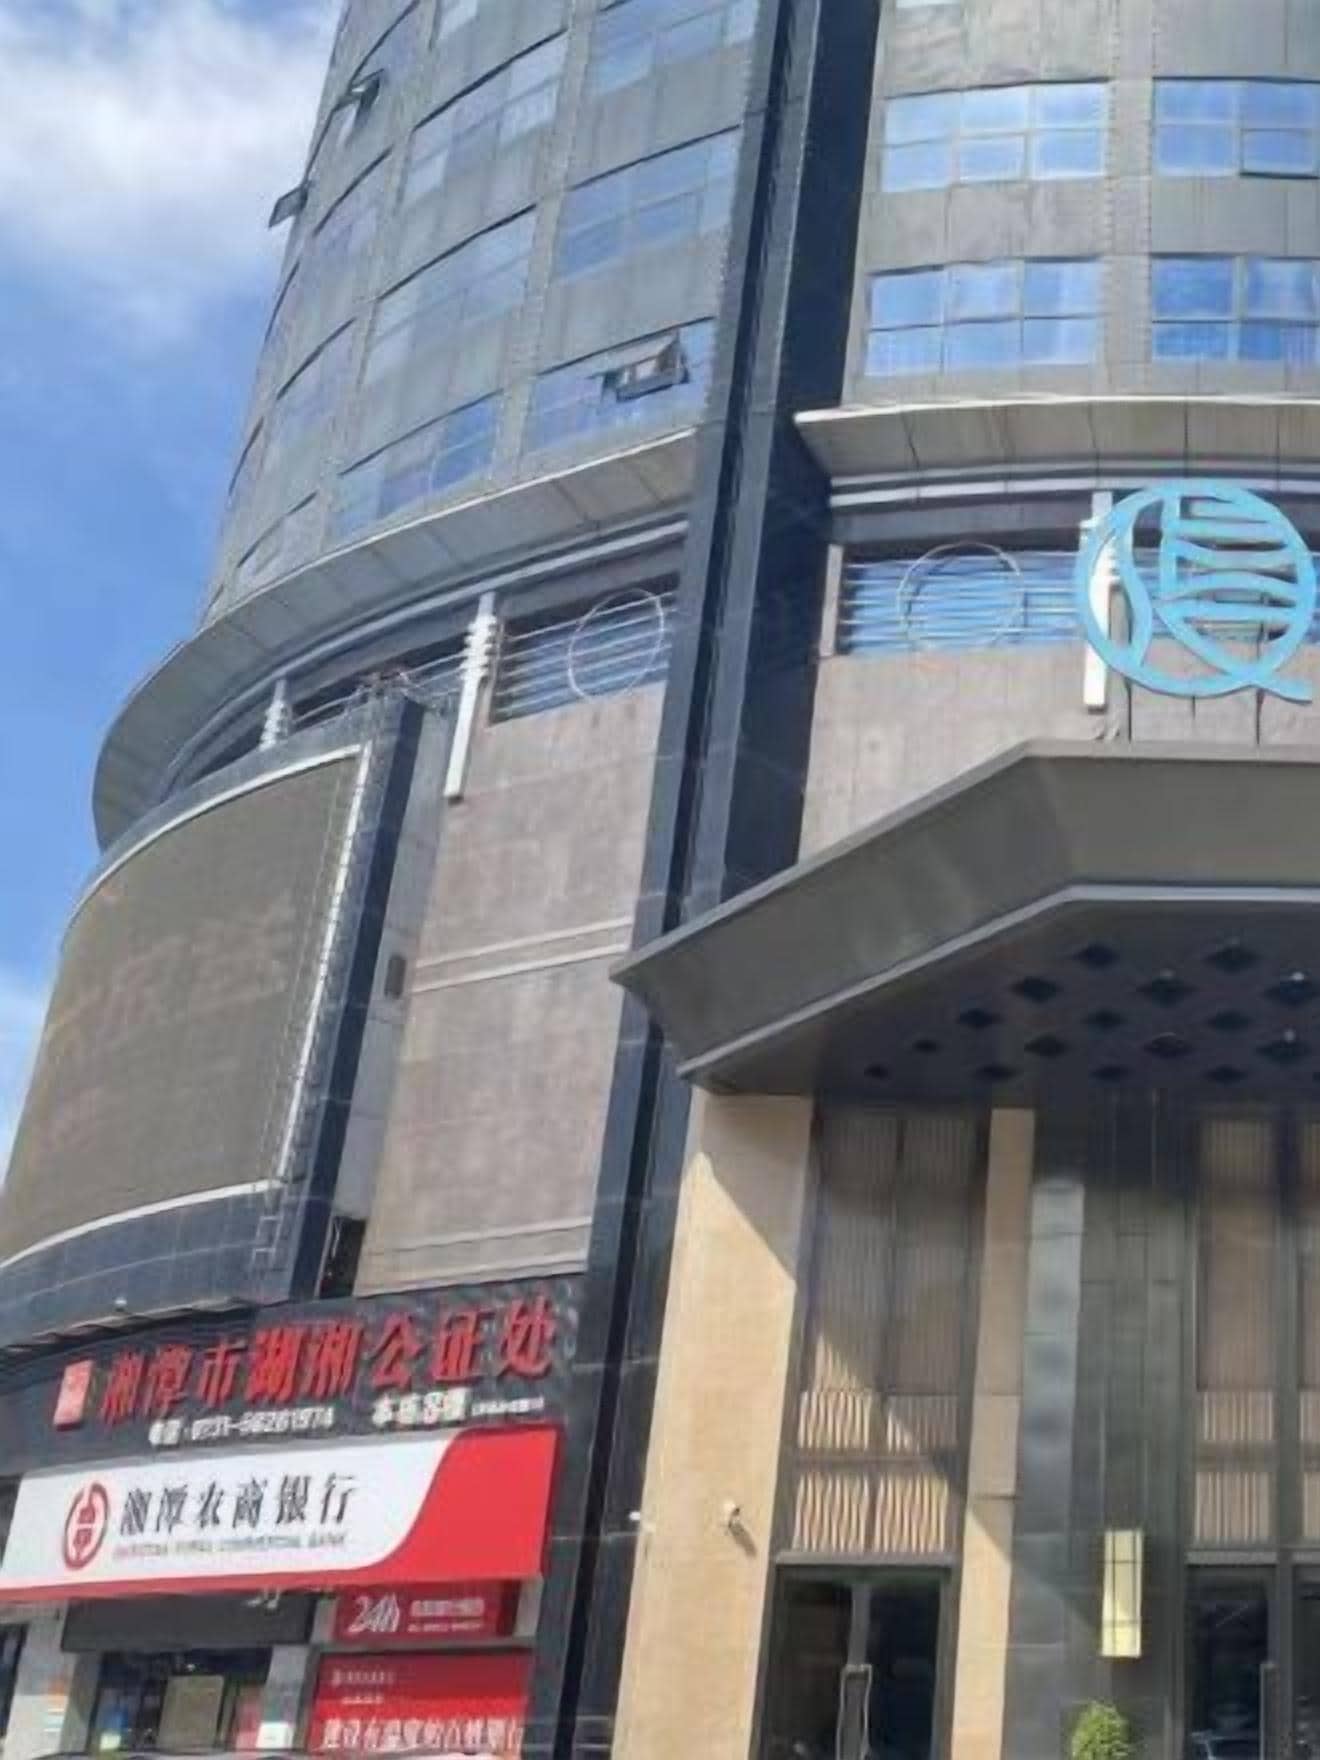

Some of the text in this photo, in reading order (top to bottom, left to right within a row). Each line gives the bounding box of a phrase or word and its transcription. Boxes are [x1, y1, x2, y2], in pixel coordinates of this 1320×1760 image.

[119, 1472, 356, 1537] 湘潭农商银行
